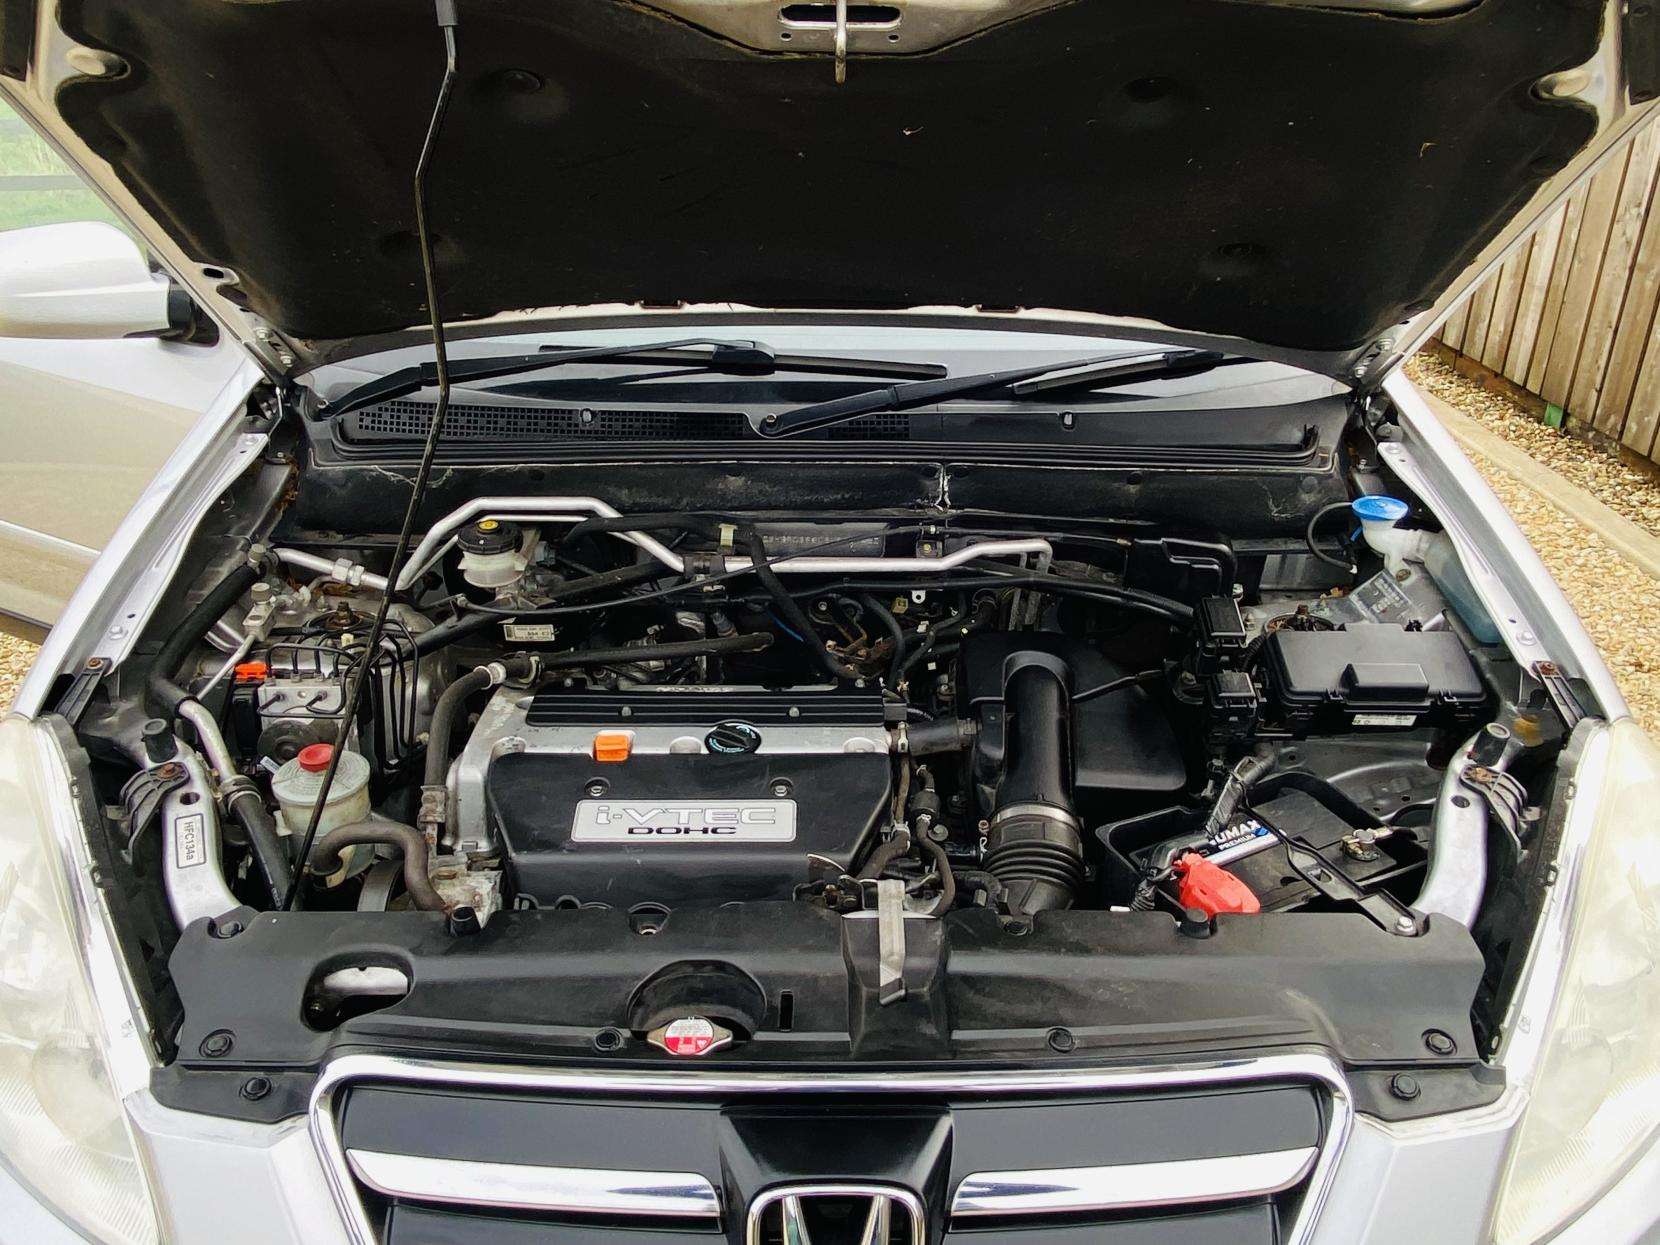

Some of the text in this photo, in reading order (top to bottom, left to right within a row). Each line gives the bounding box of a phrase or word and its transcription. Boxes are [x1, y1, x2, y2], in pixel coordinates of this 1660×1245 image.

[595, 806, 776, 826] i-VTEC
[183, 821, 196, 861] HFC134a
[627, 826, 737, 835] DOHC
[1208, 819, 1262, 846] UMAX
